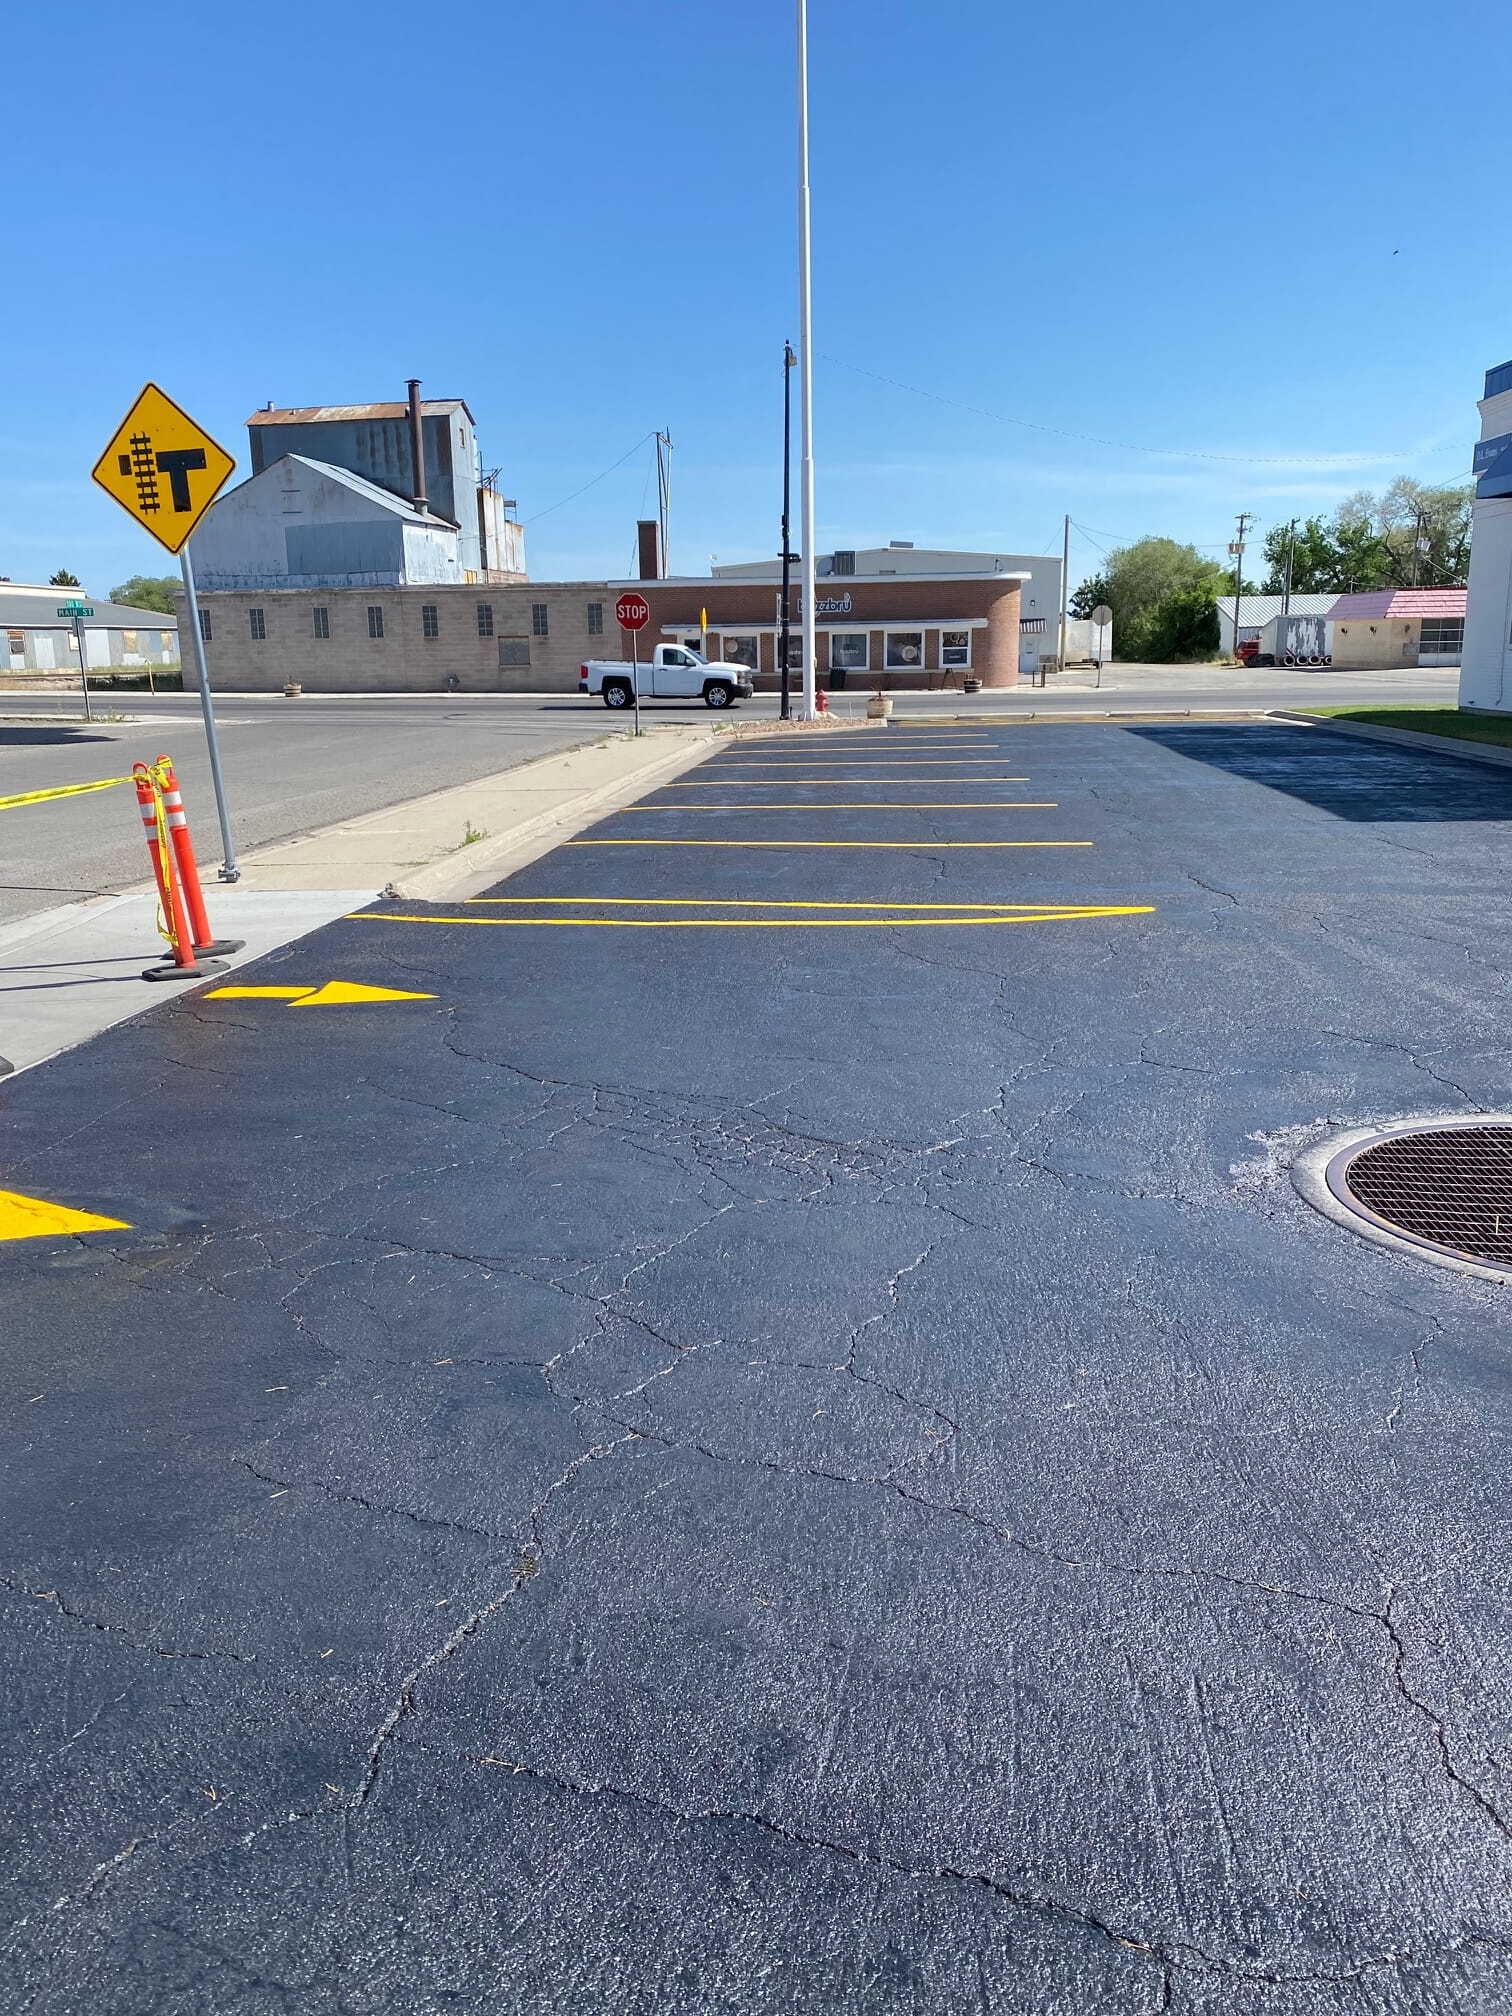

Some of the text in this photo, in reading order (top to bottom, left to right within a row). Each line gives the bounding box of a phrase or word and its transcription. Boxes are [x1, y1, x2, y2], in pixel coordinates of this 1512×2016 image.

[58, 608, 92, 616] MAIN ST
[617, 604, 647, 619] STOP
